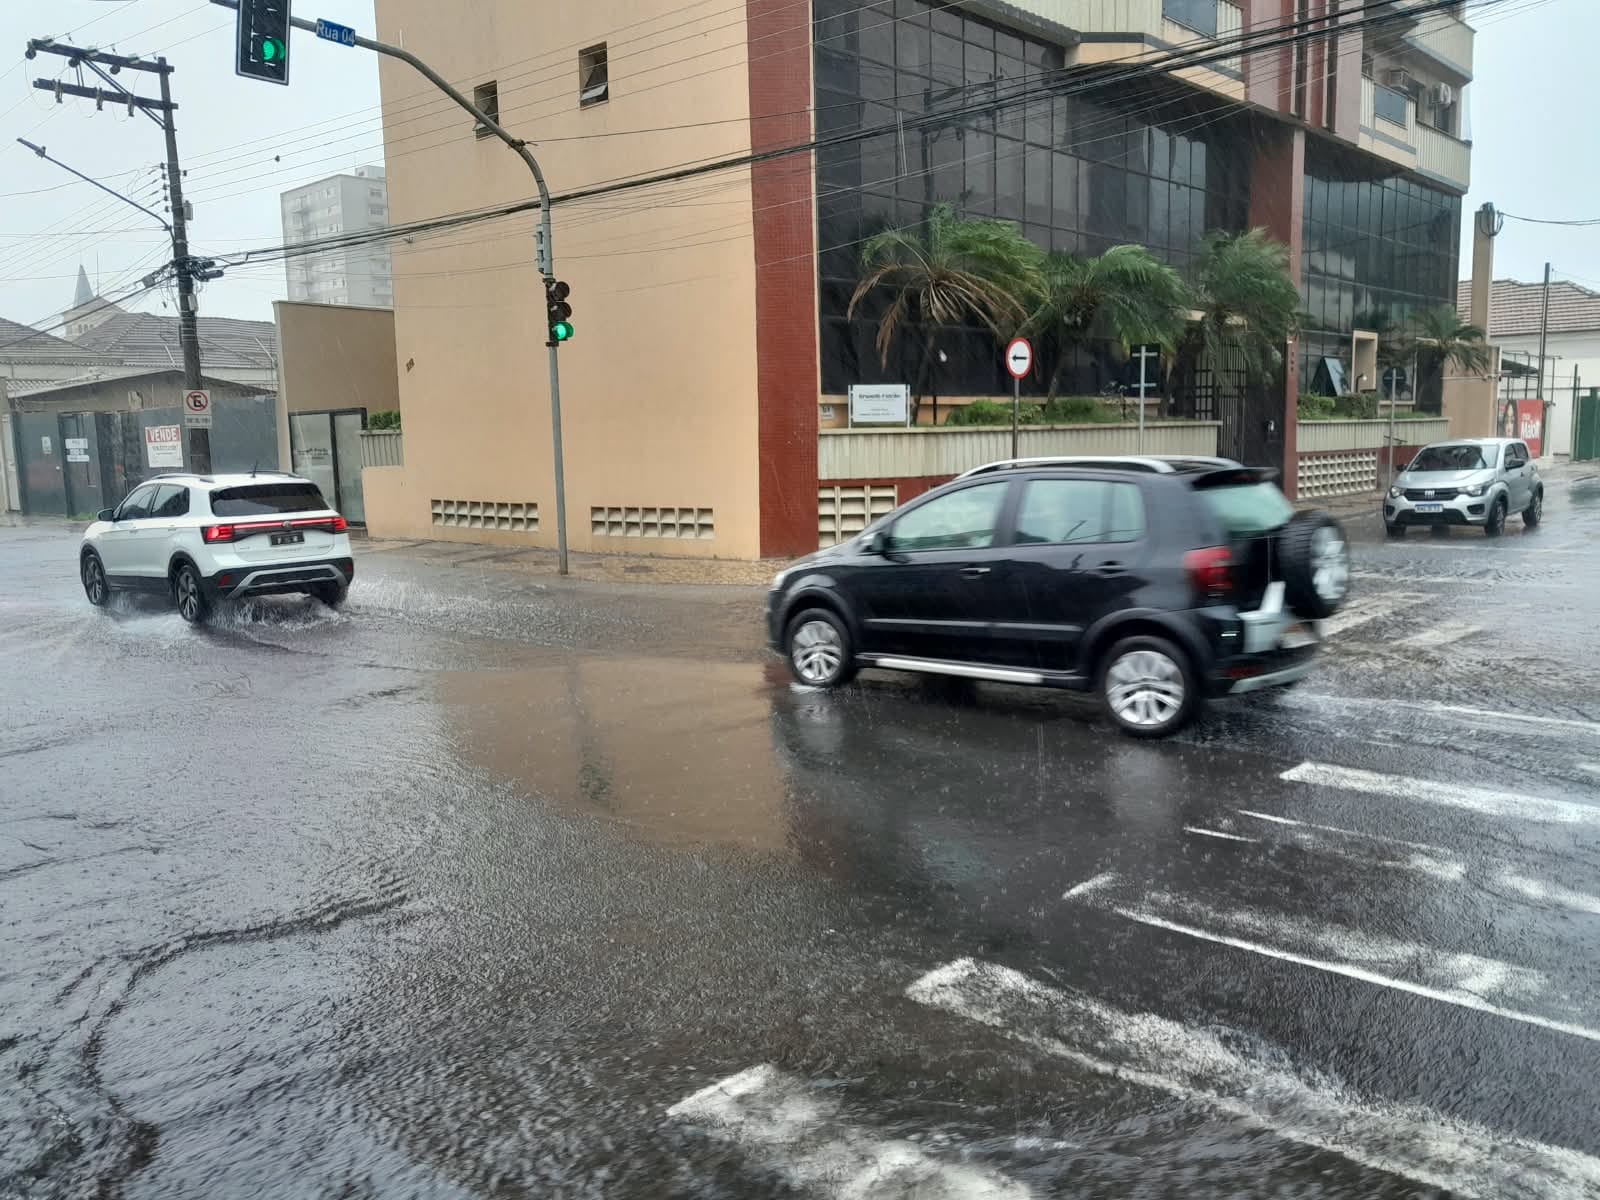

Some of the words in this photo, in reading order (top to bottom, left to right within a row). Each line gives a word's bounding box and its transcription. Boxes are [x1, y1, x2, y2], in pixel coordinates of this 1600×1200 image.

[316, 21, 338, 41] Rua
[341, 28, 355, 45] 04
[149, 427, 177, 442] VENDE
